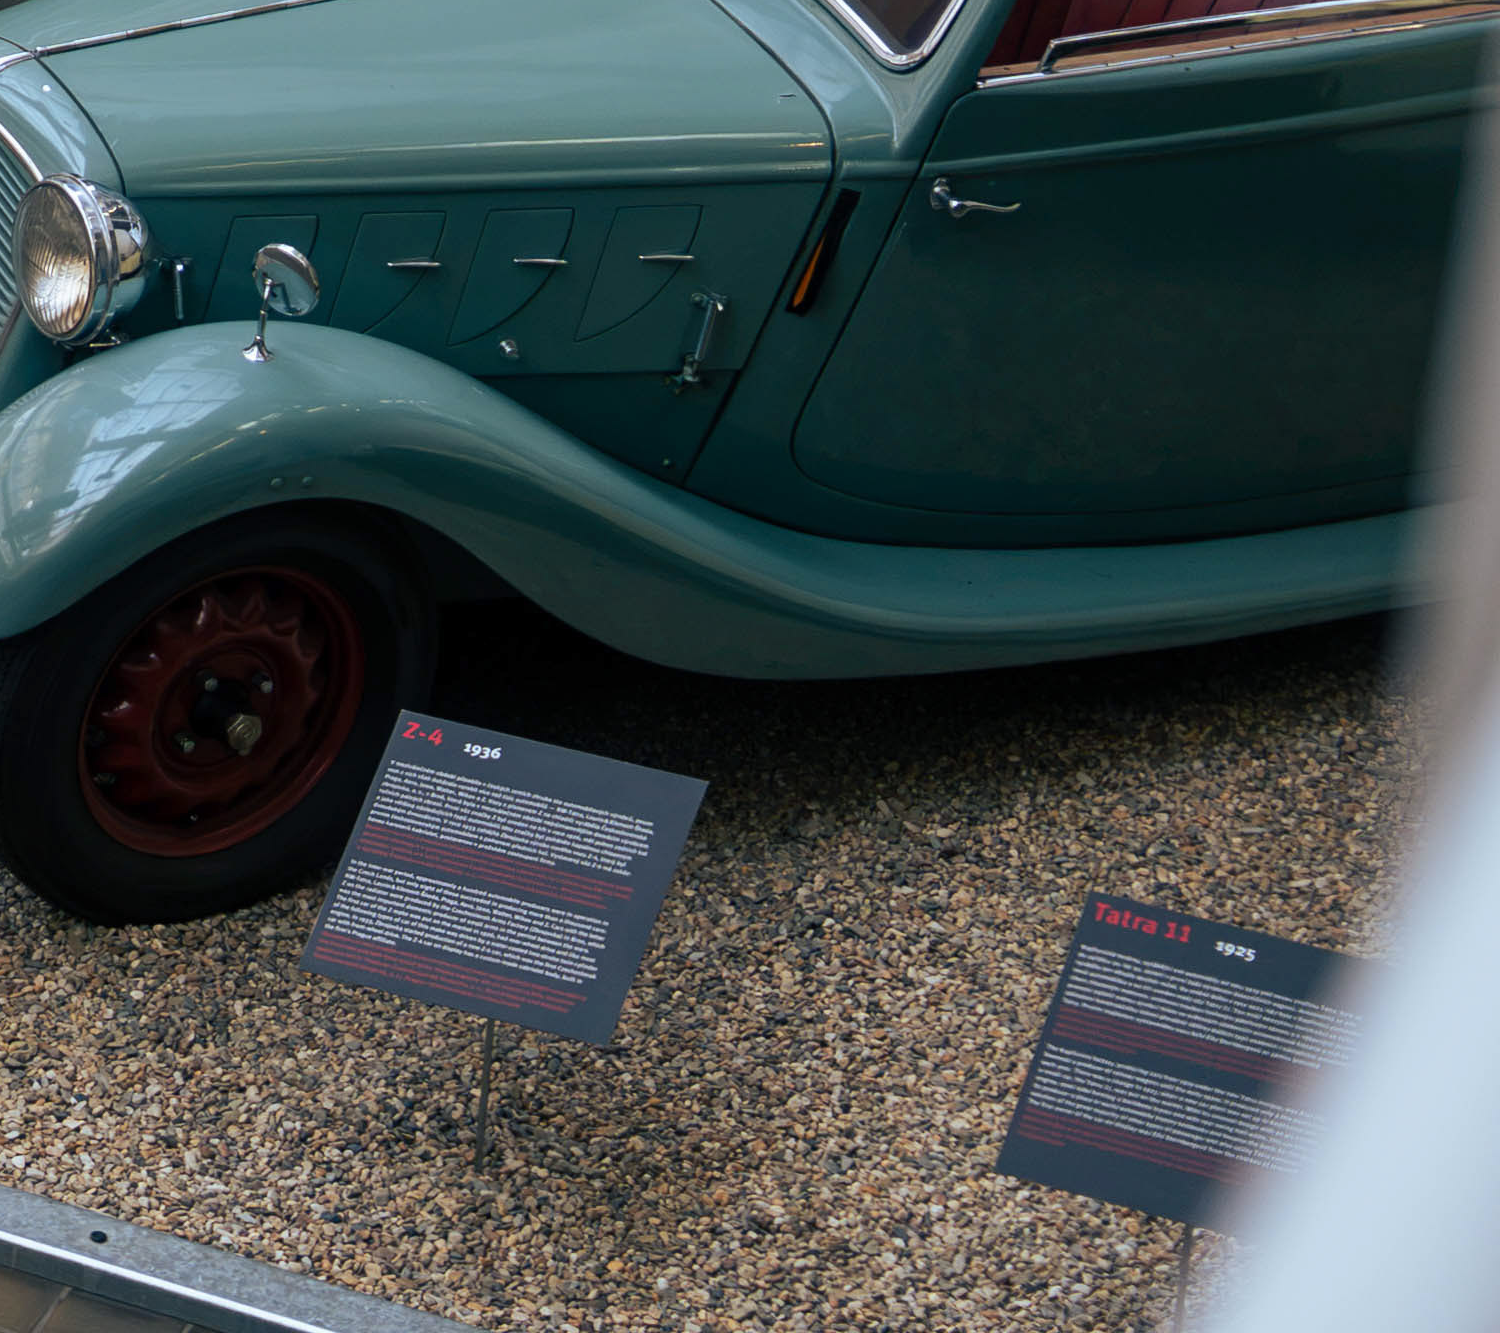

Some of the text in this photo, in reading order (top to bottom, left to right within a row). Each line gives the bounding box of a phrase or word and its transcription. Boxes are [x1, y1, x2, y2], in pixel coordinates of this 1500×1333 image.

[402, 721, 502, 761] Z-4 1936
[1093, 902, 1258, 963] Tatra 11 1925
